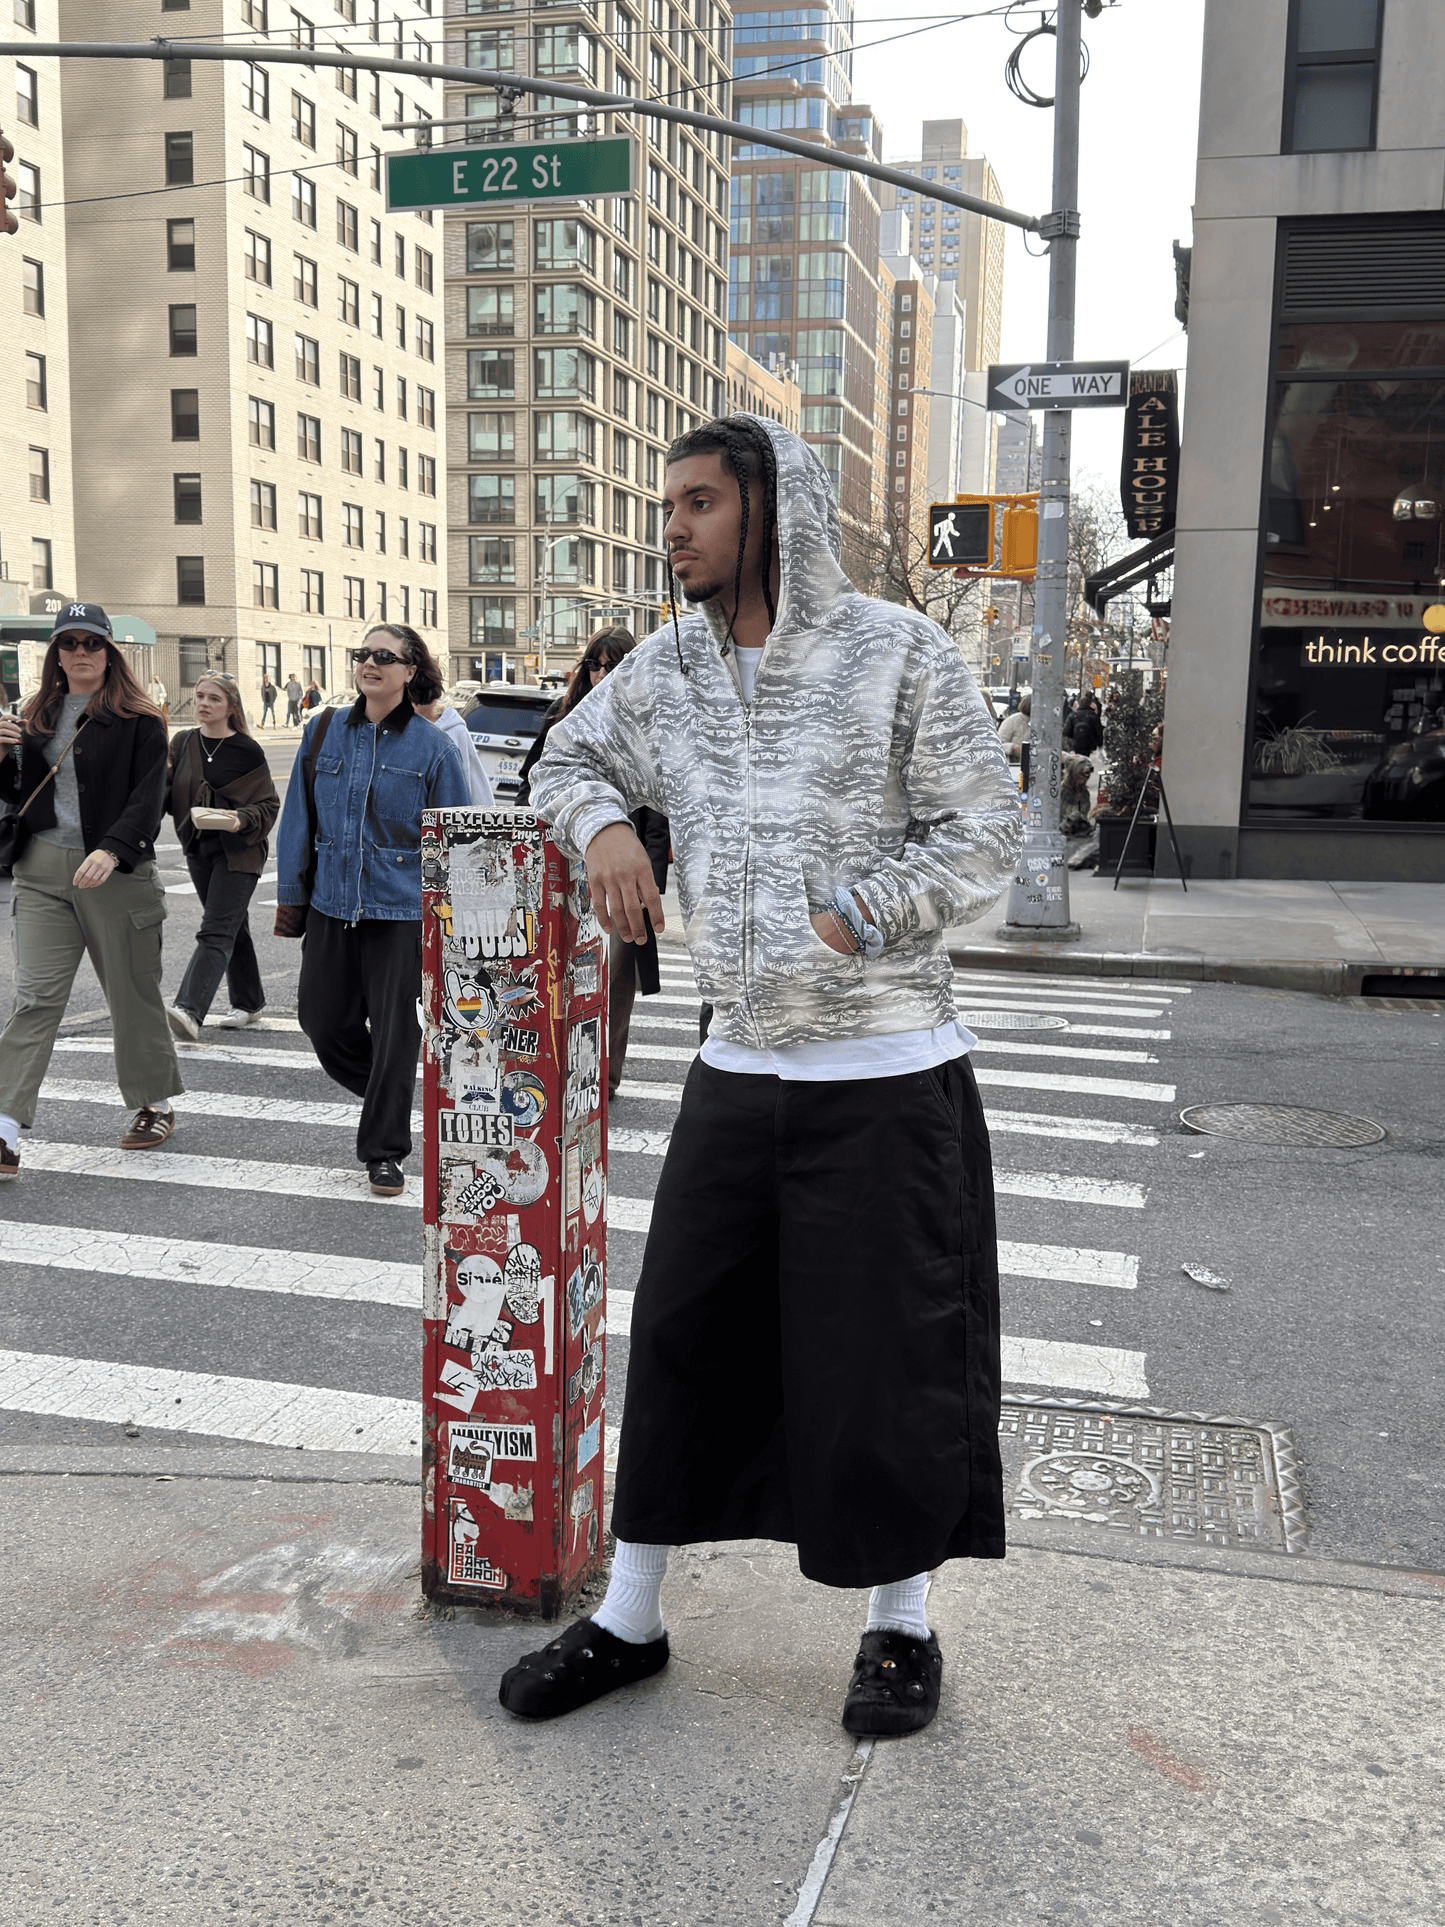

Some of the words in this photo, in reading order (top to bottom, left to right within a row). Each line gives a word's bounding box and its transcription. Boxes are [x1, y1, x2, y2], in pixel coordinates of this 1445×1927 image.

[453, 160, 468, 194] E
[482, 156, 518, 192] 22
[532, 154, 561, 189] St
[1014, 377, 1052, 396] ONE
[1072, 375, 1113, 394] WAY
[1137, 396, 1167, 446] ALE
[1131, 457, 1167, 531] HOUSE
[45, 599, 62, 613] 201
[69, 604, 86, 617] NY
[1305, 636, 1376, 664] think
[470, 733, 491, 744] YPD
[442, 812, 537, 826] FLYFLYLES
[442, 1113, 511, 1144] TOBES
[457, 1170, 492, 1203] VIANA
[452, 1428, 533, 1457] YISM
